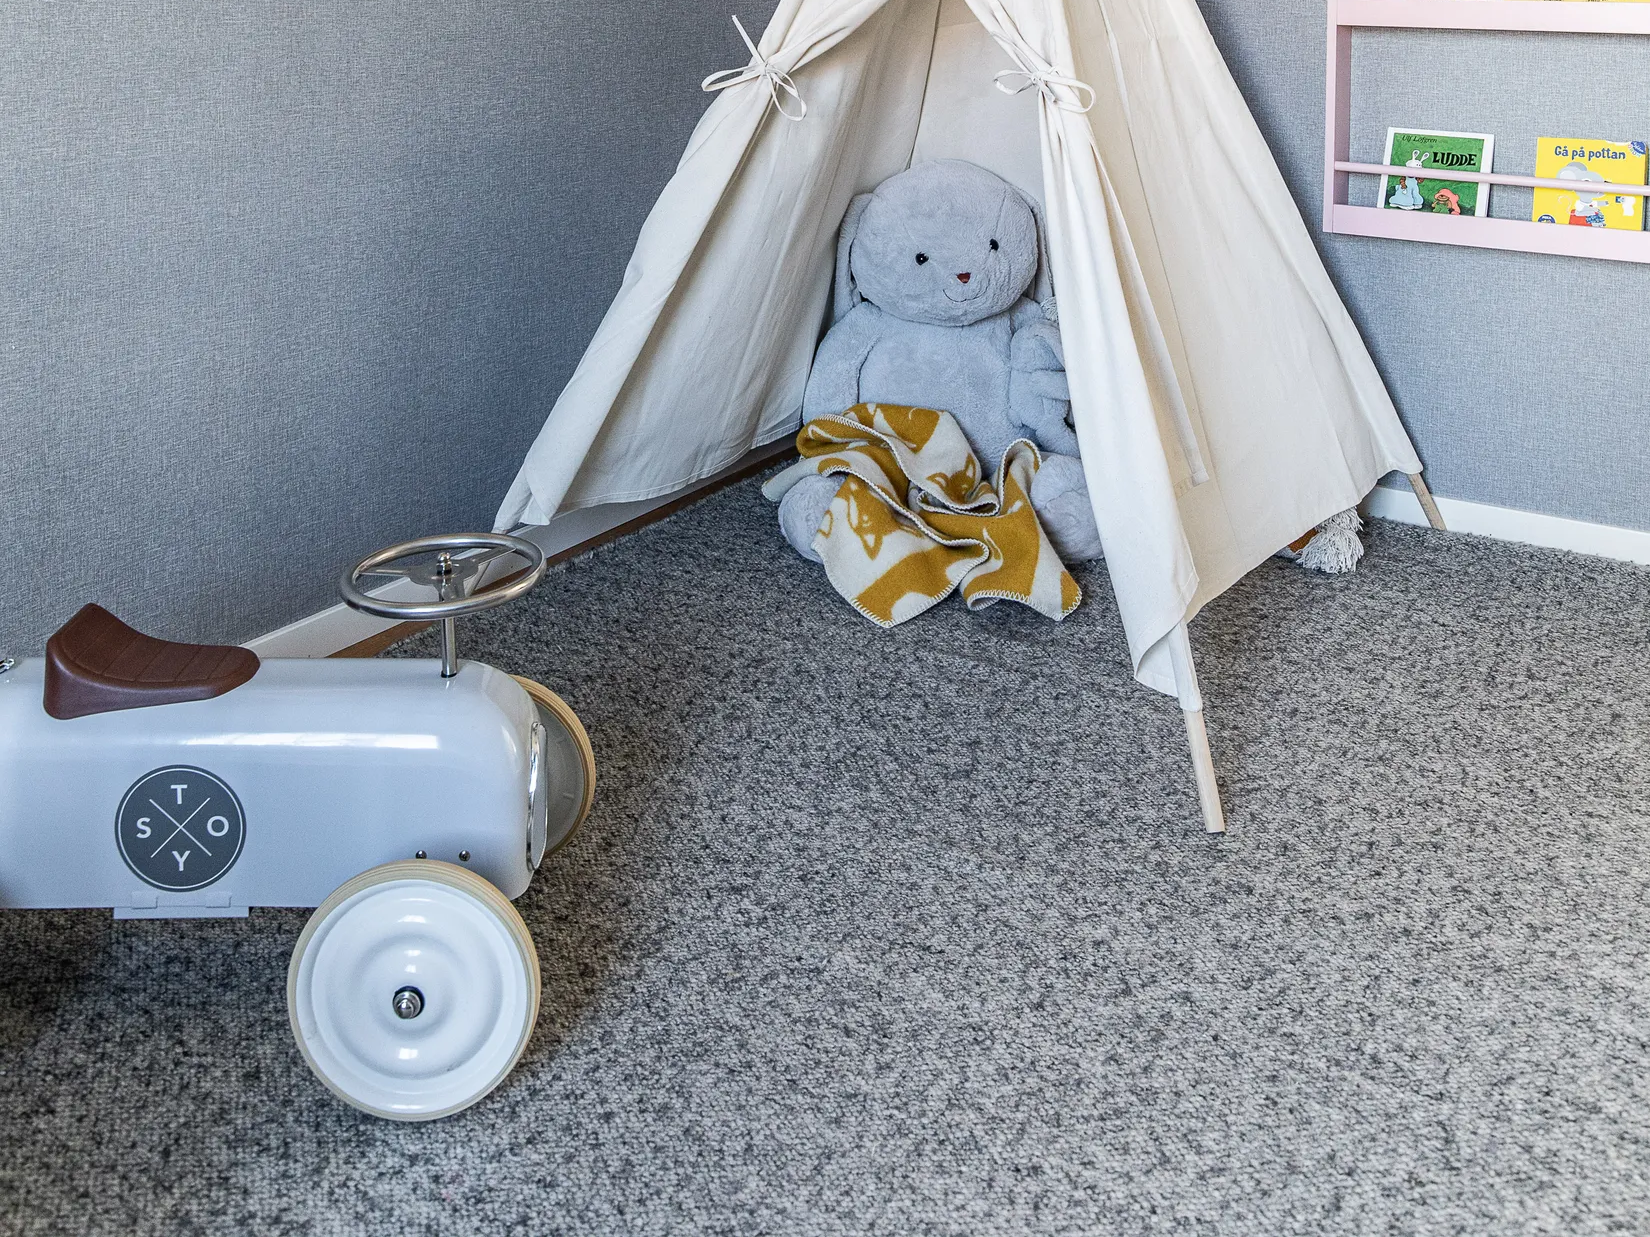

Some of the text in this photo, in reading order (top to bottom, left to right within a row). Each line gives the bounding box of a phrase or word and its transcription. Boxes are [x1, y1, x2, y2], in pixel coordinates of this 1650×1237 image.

[1432, 151, 1477, 167] LUDDE
[1554, 145, 1569, 157] Gå
[1571, 146, 1586, 161] på
[1588, 147, 1626, 162] pottan
